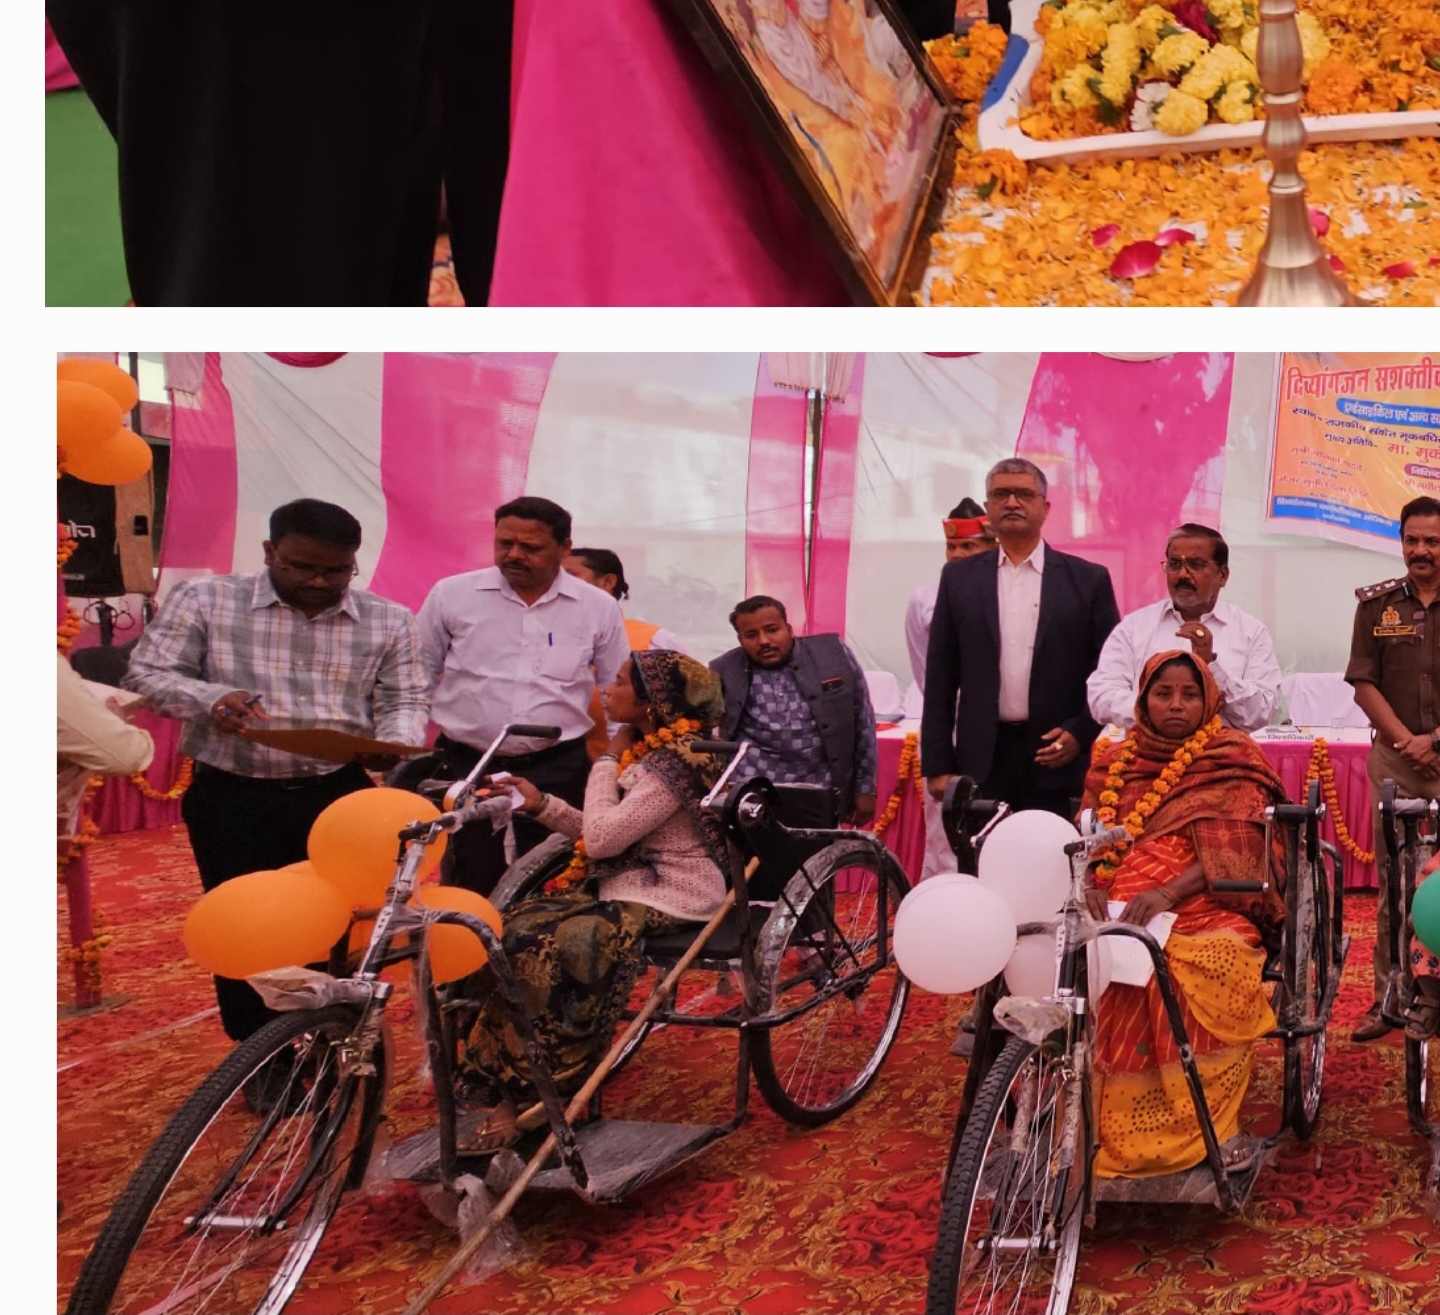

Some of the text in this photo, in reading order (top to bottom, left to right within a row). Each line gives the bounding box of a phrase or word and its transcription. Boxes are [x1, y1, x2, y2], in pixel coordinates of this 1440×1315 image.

[1286, 366, 1371, 401] दिव्यांगजन
[1394, 407, 1410, 422] एवं
[1409, 411, 1429, 423] अन्य
[1387, 442, 1409, 455] मा.
